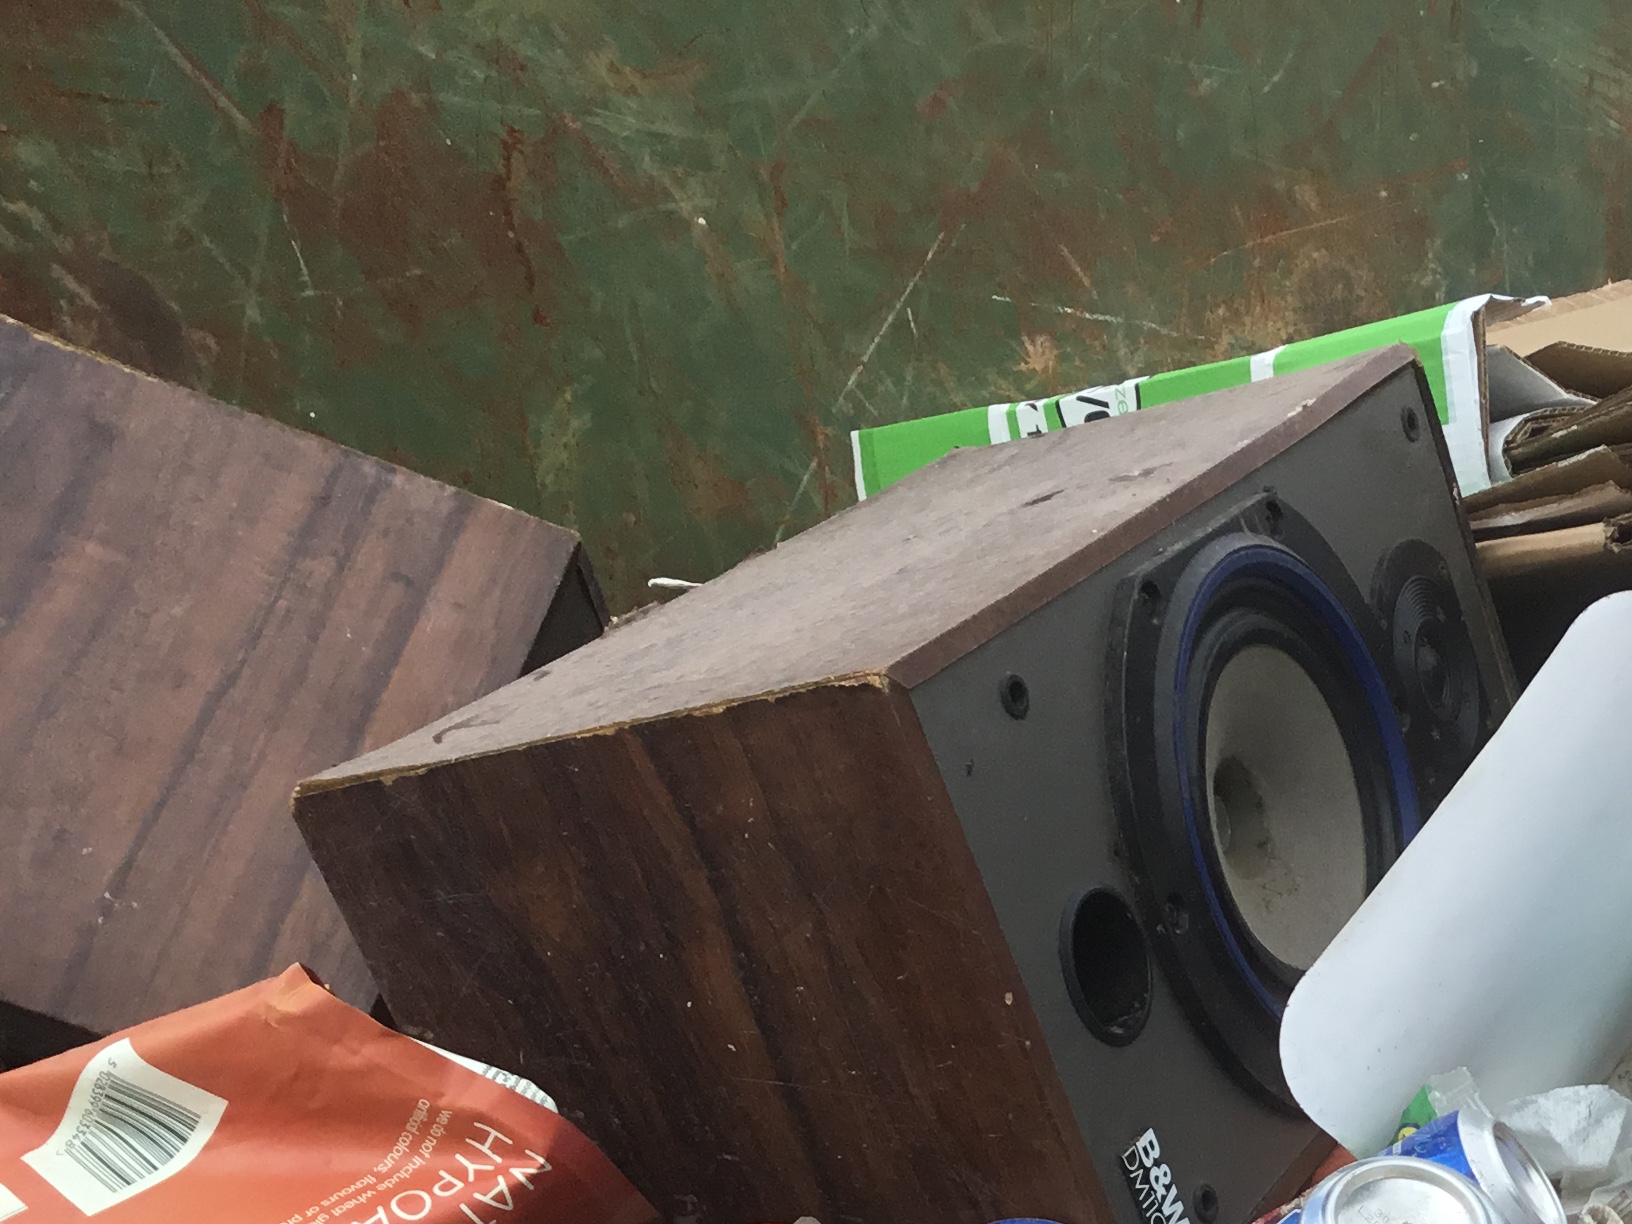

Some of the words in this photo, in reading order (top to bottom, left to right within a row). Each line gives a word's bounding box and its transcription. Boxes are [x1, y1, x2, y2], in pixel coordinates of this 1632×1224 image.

[429, 1123, 446, 1138] do
[438, 1109, 452, 1126] we
[373, 1132, 413, 1174] colours,
[420, 1134, 438, 1159] not
[376, 1156, 426, 1192] include
[320, 1173, 377, 1207] flavours
[333, 1189, 376, 1217] wheat
[304, 1204, 320, 1219] or
